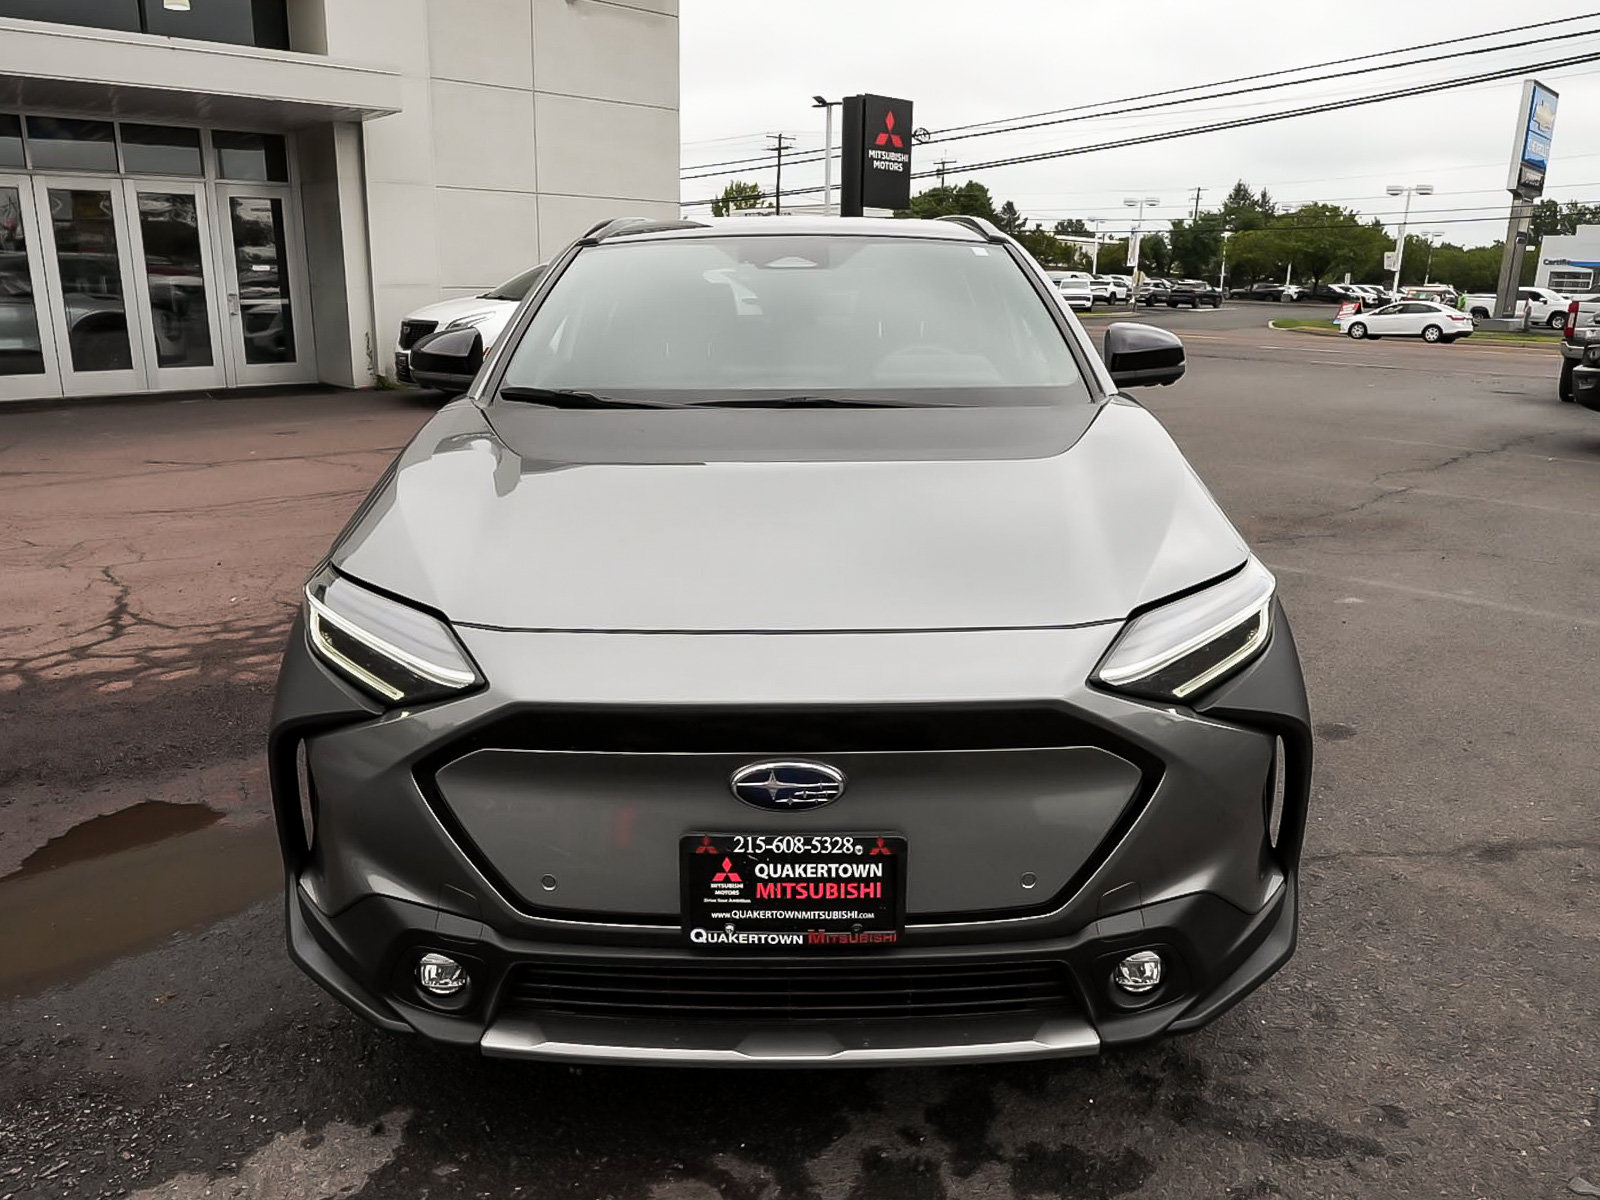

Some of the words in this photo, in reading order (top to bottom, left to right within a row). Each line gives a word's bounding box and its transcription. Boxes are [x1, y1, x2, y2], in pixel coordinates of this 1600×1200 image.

[868, 149, 909, 162] MITSUBISHI
[873, 160, 904, 172] MOTORS
[733, 835, 854, 854] 215-608-5328
[754, 863, 883, 880] QUAKERTOWN
[756, 882, 882, 899] MITSUBISHI
